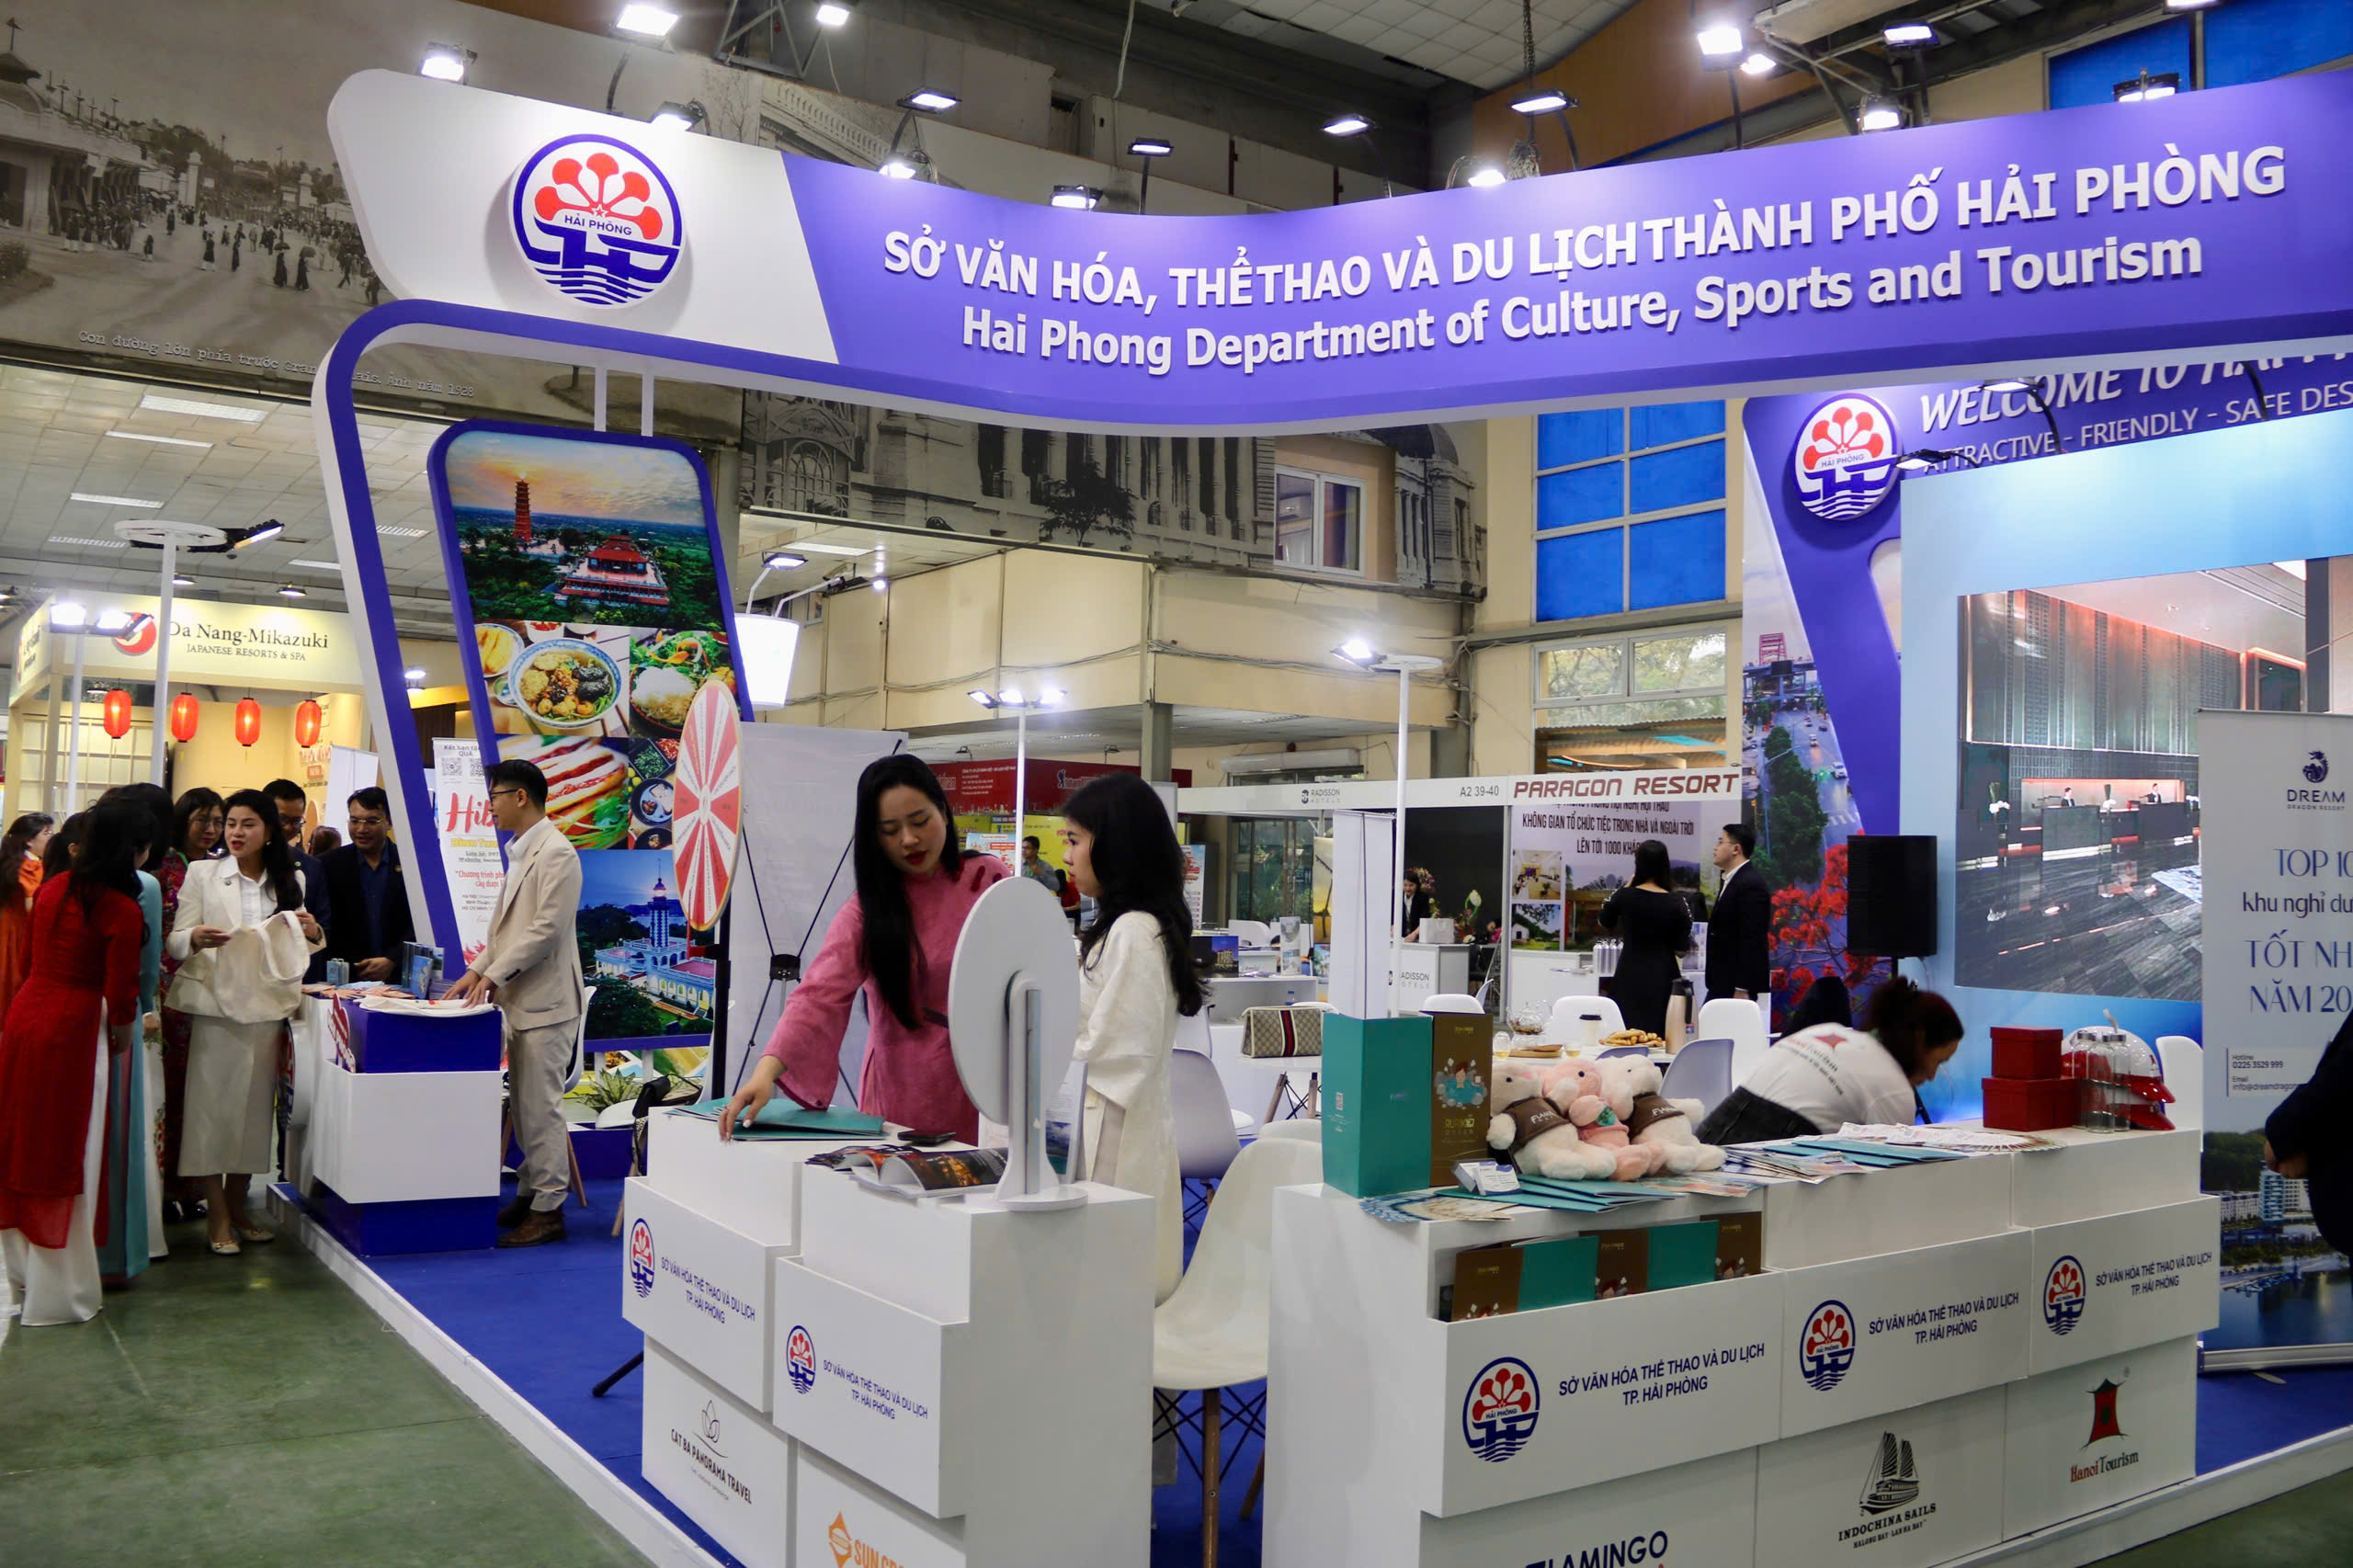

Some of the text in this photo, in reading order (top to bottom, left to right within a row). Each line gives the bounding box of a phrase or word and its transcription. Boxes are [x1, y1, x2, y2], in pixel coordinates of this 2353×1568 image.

[564, 212, 632, 235] HẢI PHÒNG
[884, 143, 2286, 315] SỞ VĂN HÓA, THỂ THAO VÀ DU LỊCH THÀNH PHỐ HẢI PHÒNG
[961, 235, 2202, 377] Hai Phong Department of Culture, Sports and Tourism
[78, 330, 106, 347] Con
[197, 348, 232, 364] phía
[448, 383, 475, 398] 1928
[2081, 407, 2199, 448] FRIENDLY
[2225, 392, 2292, 424] SAFE
[2301, 381, 2353, 412] DES
[197, 622, 329, 650] Nang-Mikazuki
[187, 643, 233, 657] JAPANESE
[235, 647, 278, 660] RESORTS
[290, 652, 306, 662] SPA
[1311, 789, 1341, 797] RADISSON
[1460, 786, 1500, 798] A2 39-40
[1514, 774, 1739, 799] PARAGON RESORT
[2287, 789, 2346, 803] DREAM
[446, 792, 494, 834] Hib
[1522, 813, 1547, 829] KHÔNG
[1548, 815, 1564, 830] GIAN
[1613, 819, 1634, 833] TRONG
[1576, 839, 1590, 854] LÊN
[1605, 841, 1621, 855] 1000
[2274, 848, 2329, 877] TOP
[2243, 891, 2325, 918] khu nghỉ
[2244, 928, 2353, 969] TỐT NH
[1400, 971, 1430, 982] ADISSON
[2250, 977, 2353, 1013] NĂM 20
[1869, 1320, 1884, 1335] SỞ
[1948, 1301, 1972, 1319] THAO
[1972, 1295, 1984, 1313] VÀ
[1986, 1296, 1998, 1311] DU
[1915, 1330, 1927, 1345] TP.
[1947, 1319, 1977, 1338] PHÒNG
[1559, 1375, 1580, 1397] SỞ
[1582, 1370, 1608, 1392] VĂN
[1610, 1366, 1639, 1386] HÓA
[1667, 1356, 1700, 1377] THAO
[1702, 1348, 1719, 1369] VÀ
[1722, 1347, 1738, 1365] DU
[1740, 1342, 1765, 1364] LỊCH
[1622, 1375, 1708, 1406] TP. HẢI PHÒNG
[727, 1473, 752, 1505] TRAVEL
[1838, 1503, 1937, 1541] INDOCHINA SAILS
[1525, 1530, 1668, 1568] AMINGO
